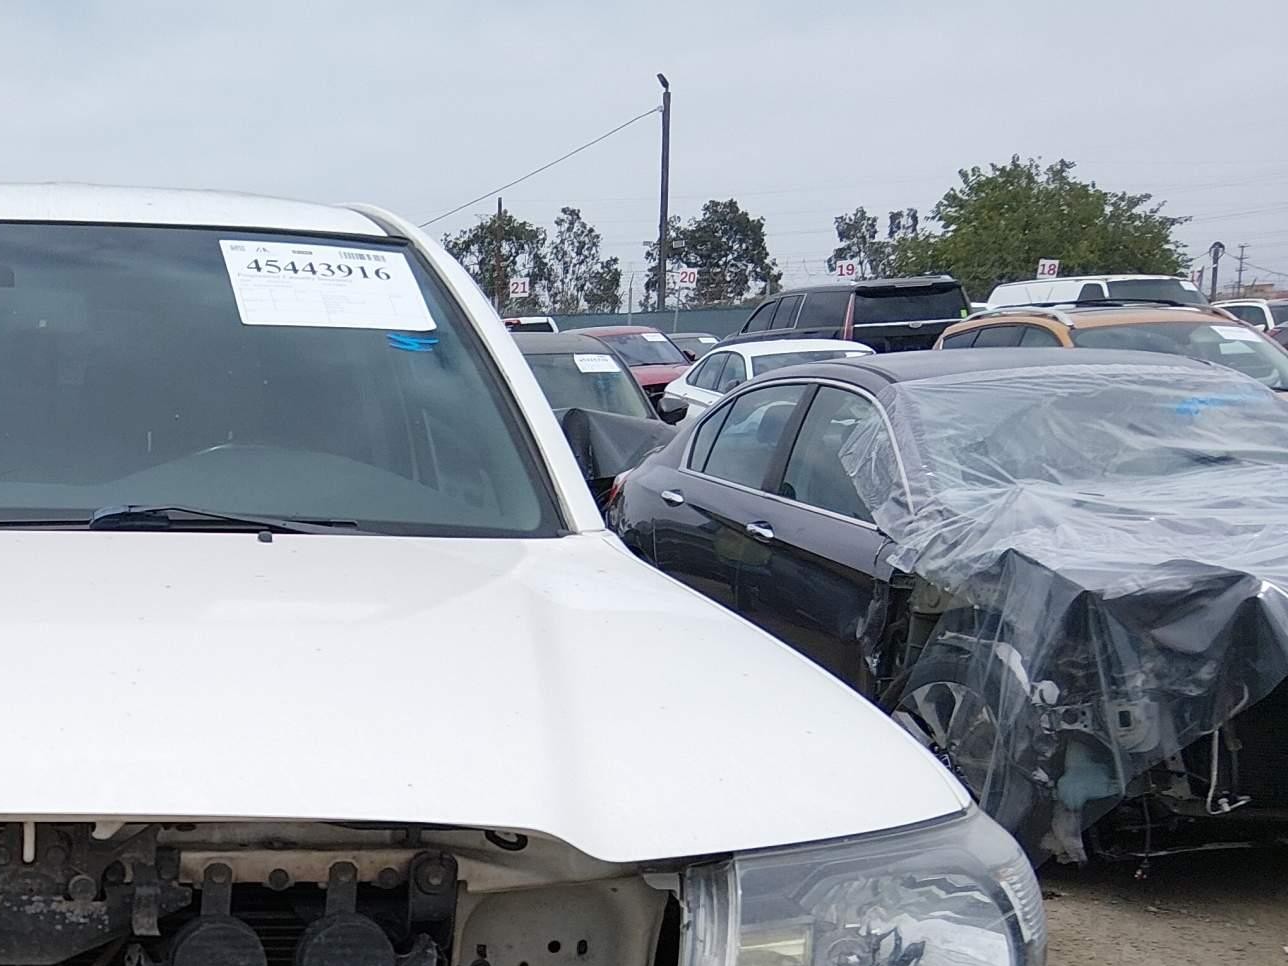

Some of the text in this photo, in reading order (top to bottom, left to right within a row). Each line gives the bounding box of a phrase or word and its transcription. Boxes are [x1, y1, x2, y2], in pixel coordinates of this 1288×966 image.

[246, 258, 391, 281] 45443916
[837, 263, 854, 276] 19
[1039, 263, 1057, 276] 18
[679, 270, 696, 284] 20
[511, 281, 528, 294] 21
